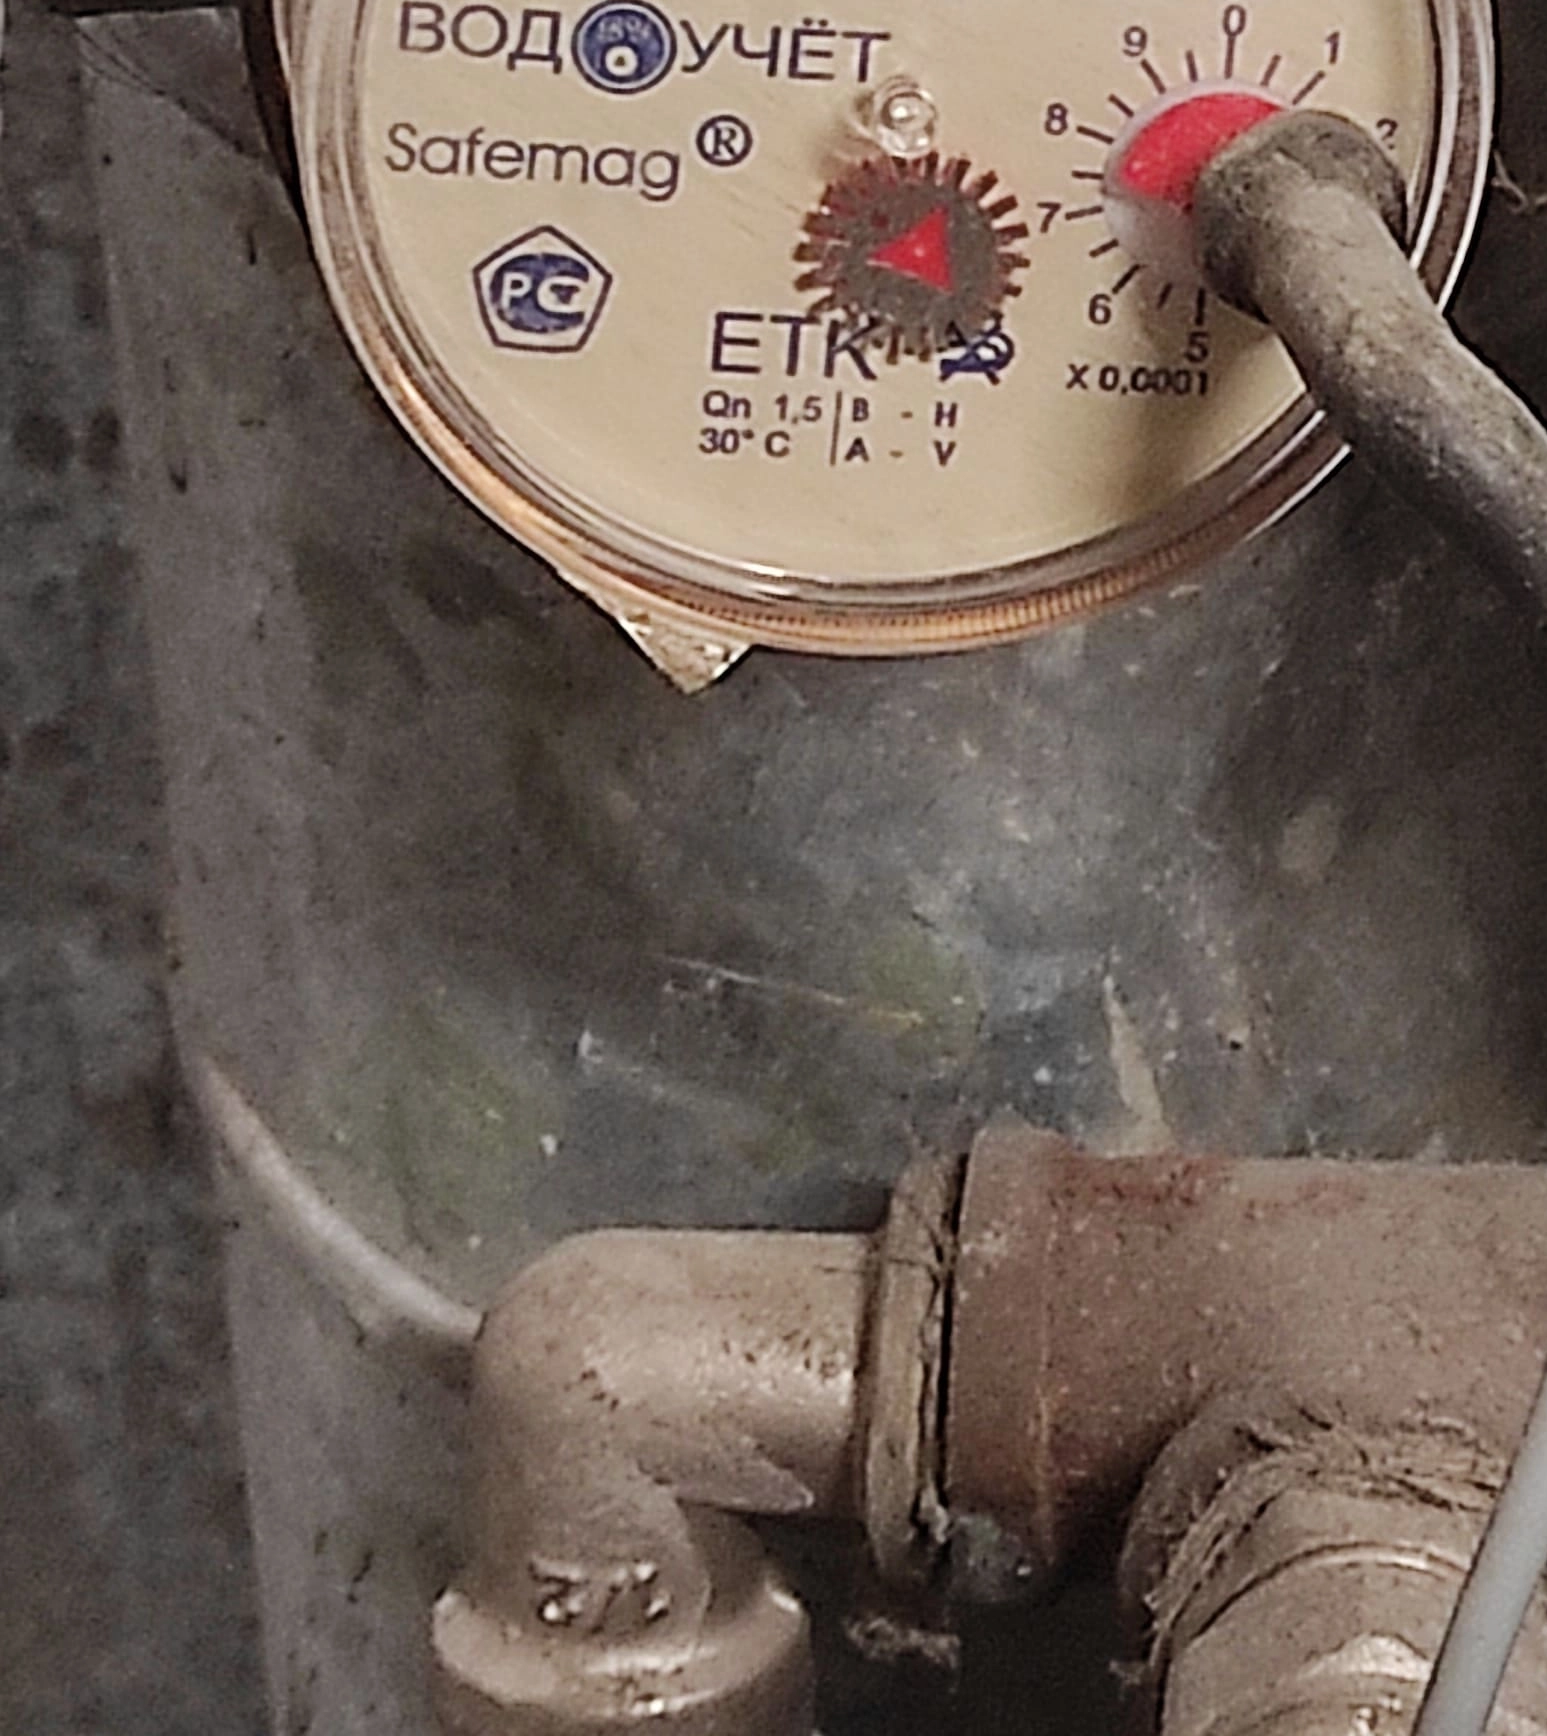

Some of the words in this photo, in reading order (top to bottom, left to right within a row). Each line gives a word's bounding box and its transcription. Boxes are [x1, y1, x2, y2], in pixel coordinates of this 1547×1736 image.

[1223, 4, 1246, 38] 0
[1123, 26, 1148, 57] 9
[1326, 32, 1341, 64] 1
[1044, 103, 1068, 135] 8
[1037, 202, 1062, 233] 7
[1088, 294, 1112, 325] 6
[711, 311, 877, 381] ETK
[1185, 331, 1209, 363] 5
[703, 390, 751, 418] Qn
[775, 394, 822, 424] 1,5
[852, 398, 869, 422] B
[934, 402, 957, 427] H
[845, 437, 869, 462] A
[934, 441, 956, 467] V
